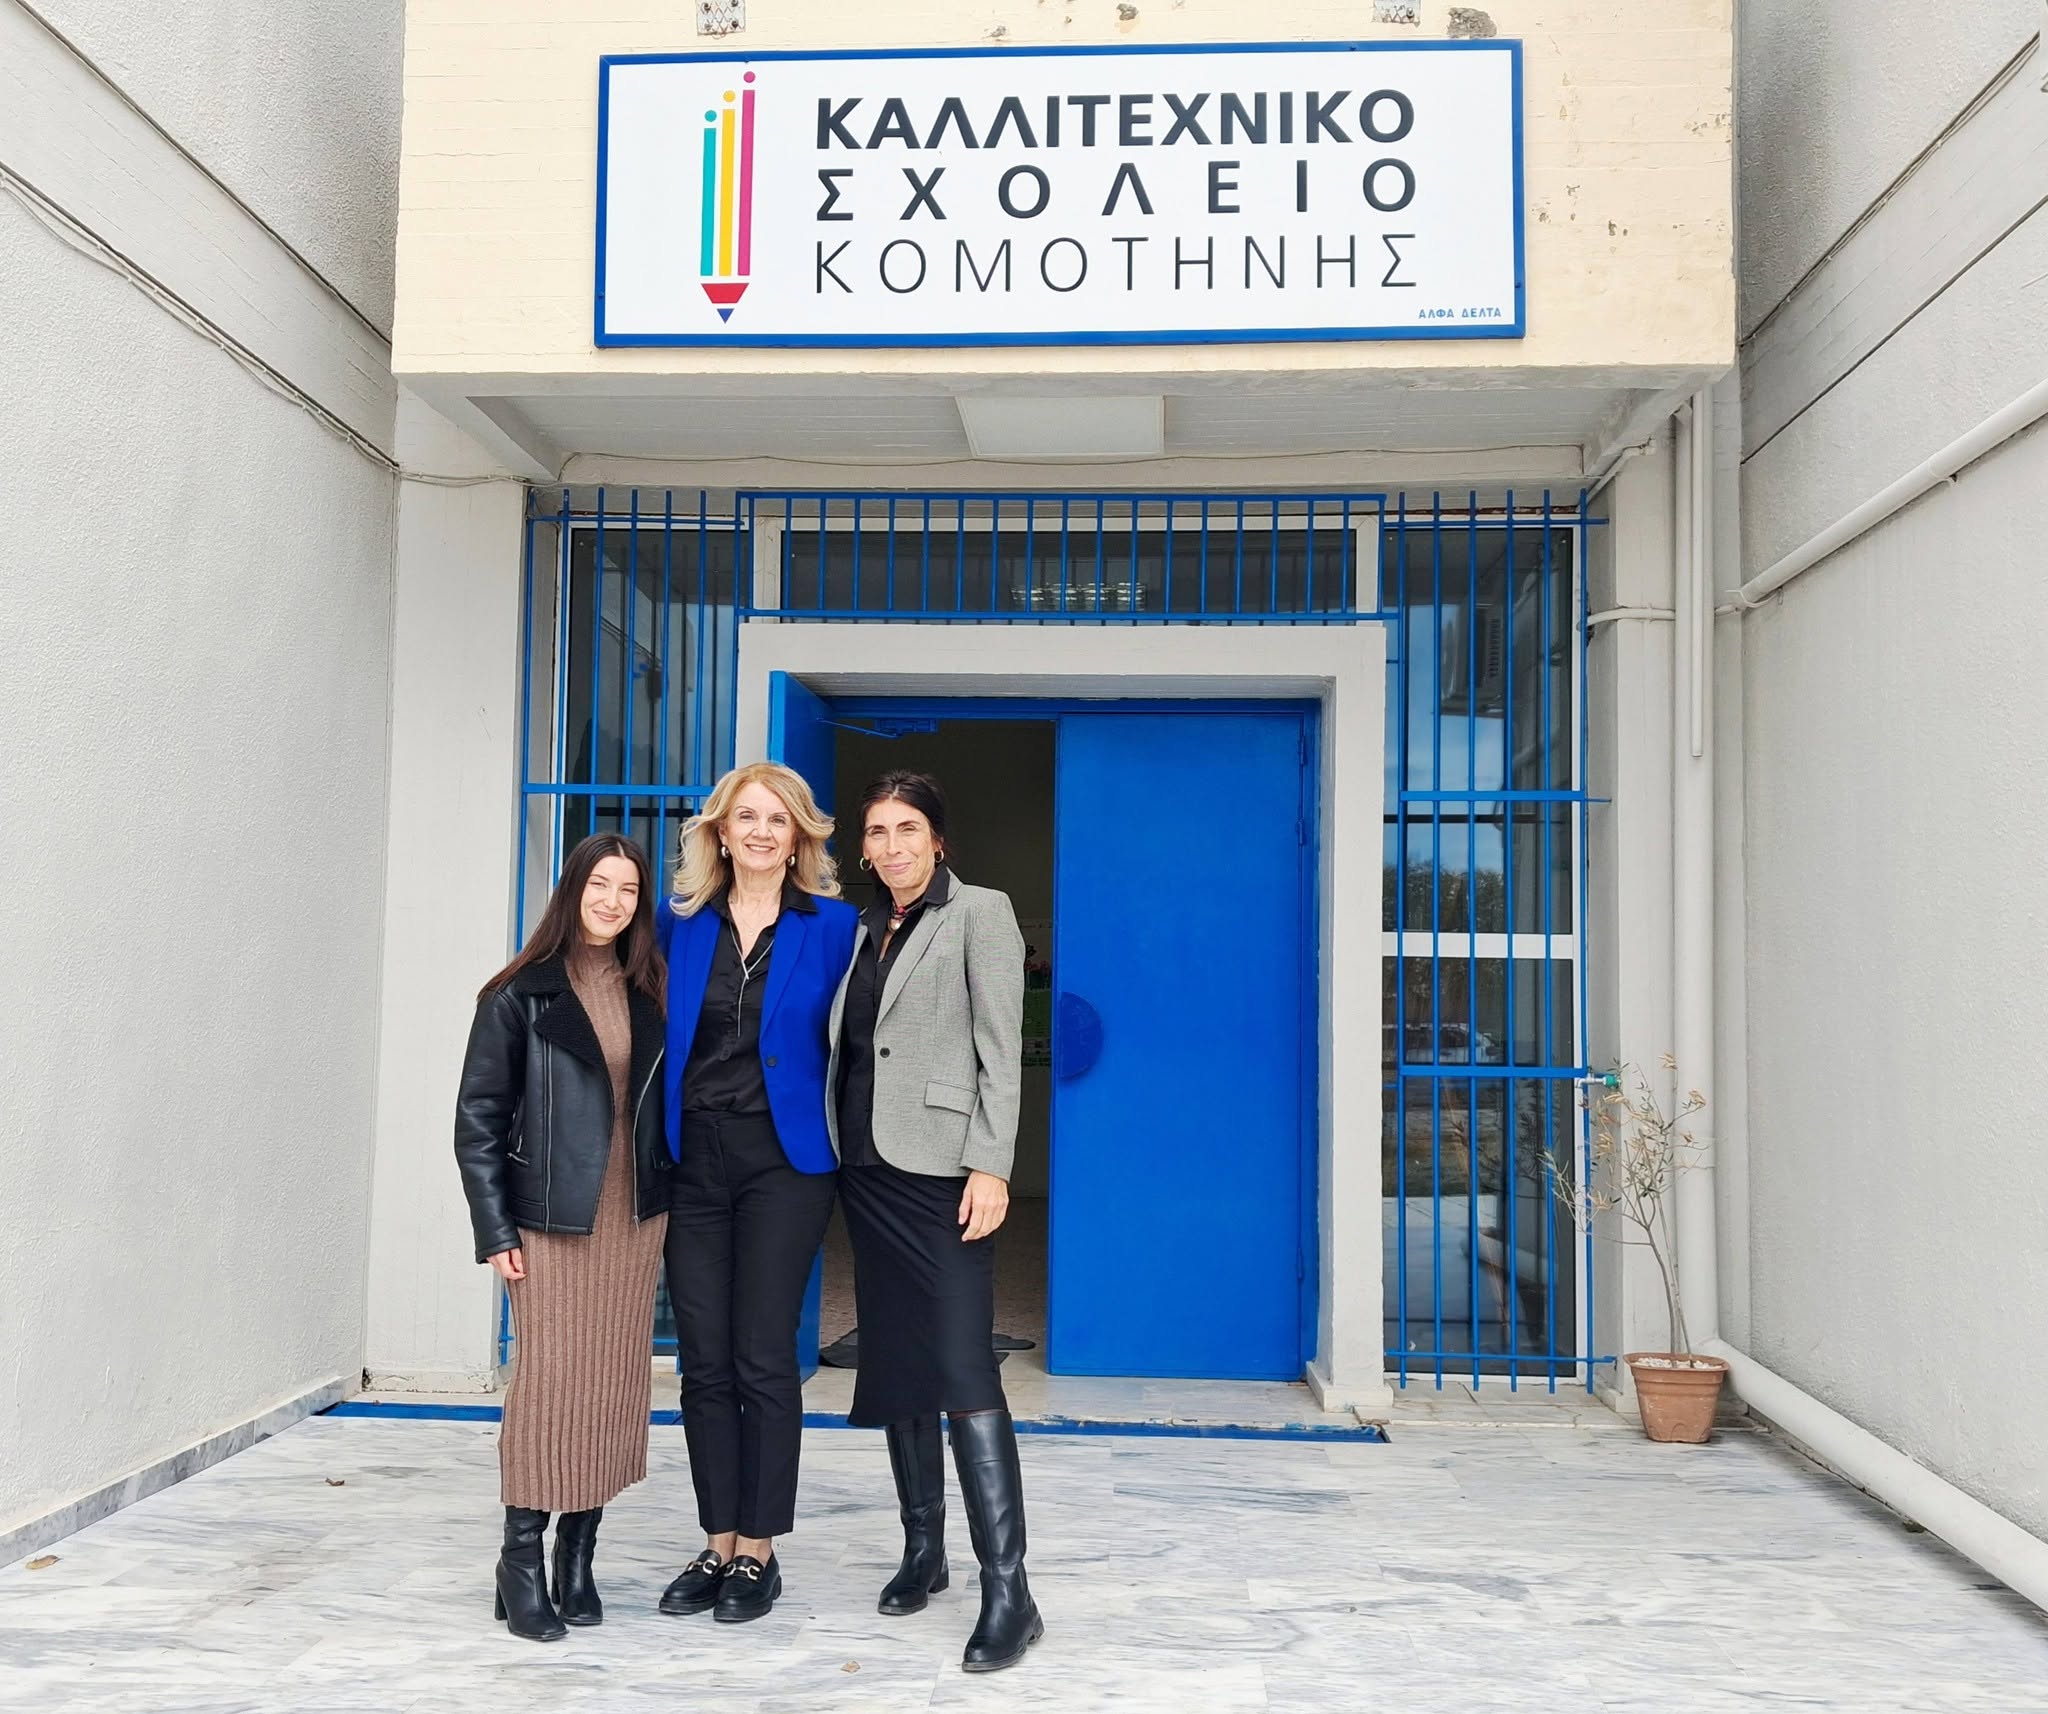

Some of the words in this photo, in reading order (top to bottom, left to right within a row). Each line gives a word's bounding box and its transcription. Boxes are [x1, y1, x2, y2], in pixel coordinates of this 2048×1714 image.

[816, 89, 1415, 150] ΚΑΛΛΙΤΕΧΝΙΚΟ
[816, 158, 1416, 222] ΣΧΟΛΕΙΟ
[816, 233, 1417, 294] ΚΟΜΟΤΗΝΗΣ
[1418, 308, 1454, 319] ΑΛΦΑ
[1461, 307, 1502, 318] ΔΕΛΤΑ
